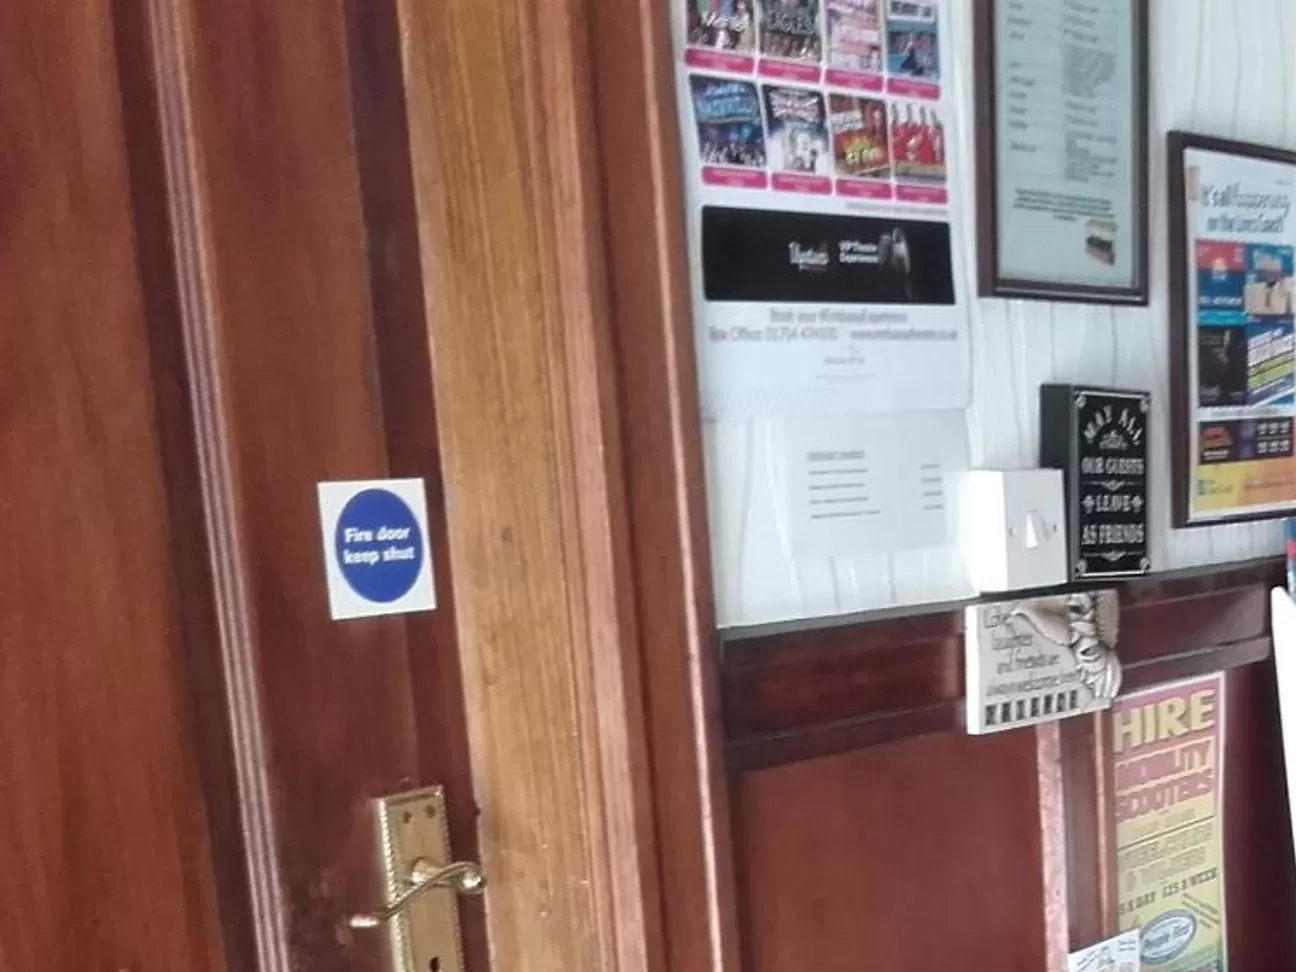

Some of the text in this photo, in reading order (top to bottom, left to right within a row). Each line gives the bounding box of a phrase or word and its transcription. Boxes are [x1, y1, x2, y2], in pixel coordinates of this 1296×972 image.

[1118, 408, 1143, 445] ALL
[1081, 456, 1144, 474] OUR GUESTS
[1095, 494, 1131, 513] LEAVE
[345, 525, 411, 543] Fire door
[1081, 523, 1144, 545] AS FRIENDS
[343, 546, 415, 567] keep shut
[1113, 688, 1216, 754] HIRE
[1114, 737, 1215, 794] MOBILITY
[1113, 770, 1215, 823] SCOOTERS
